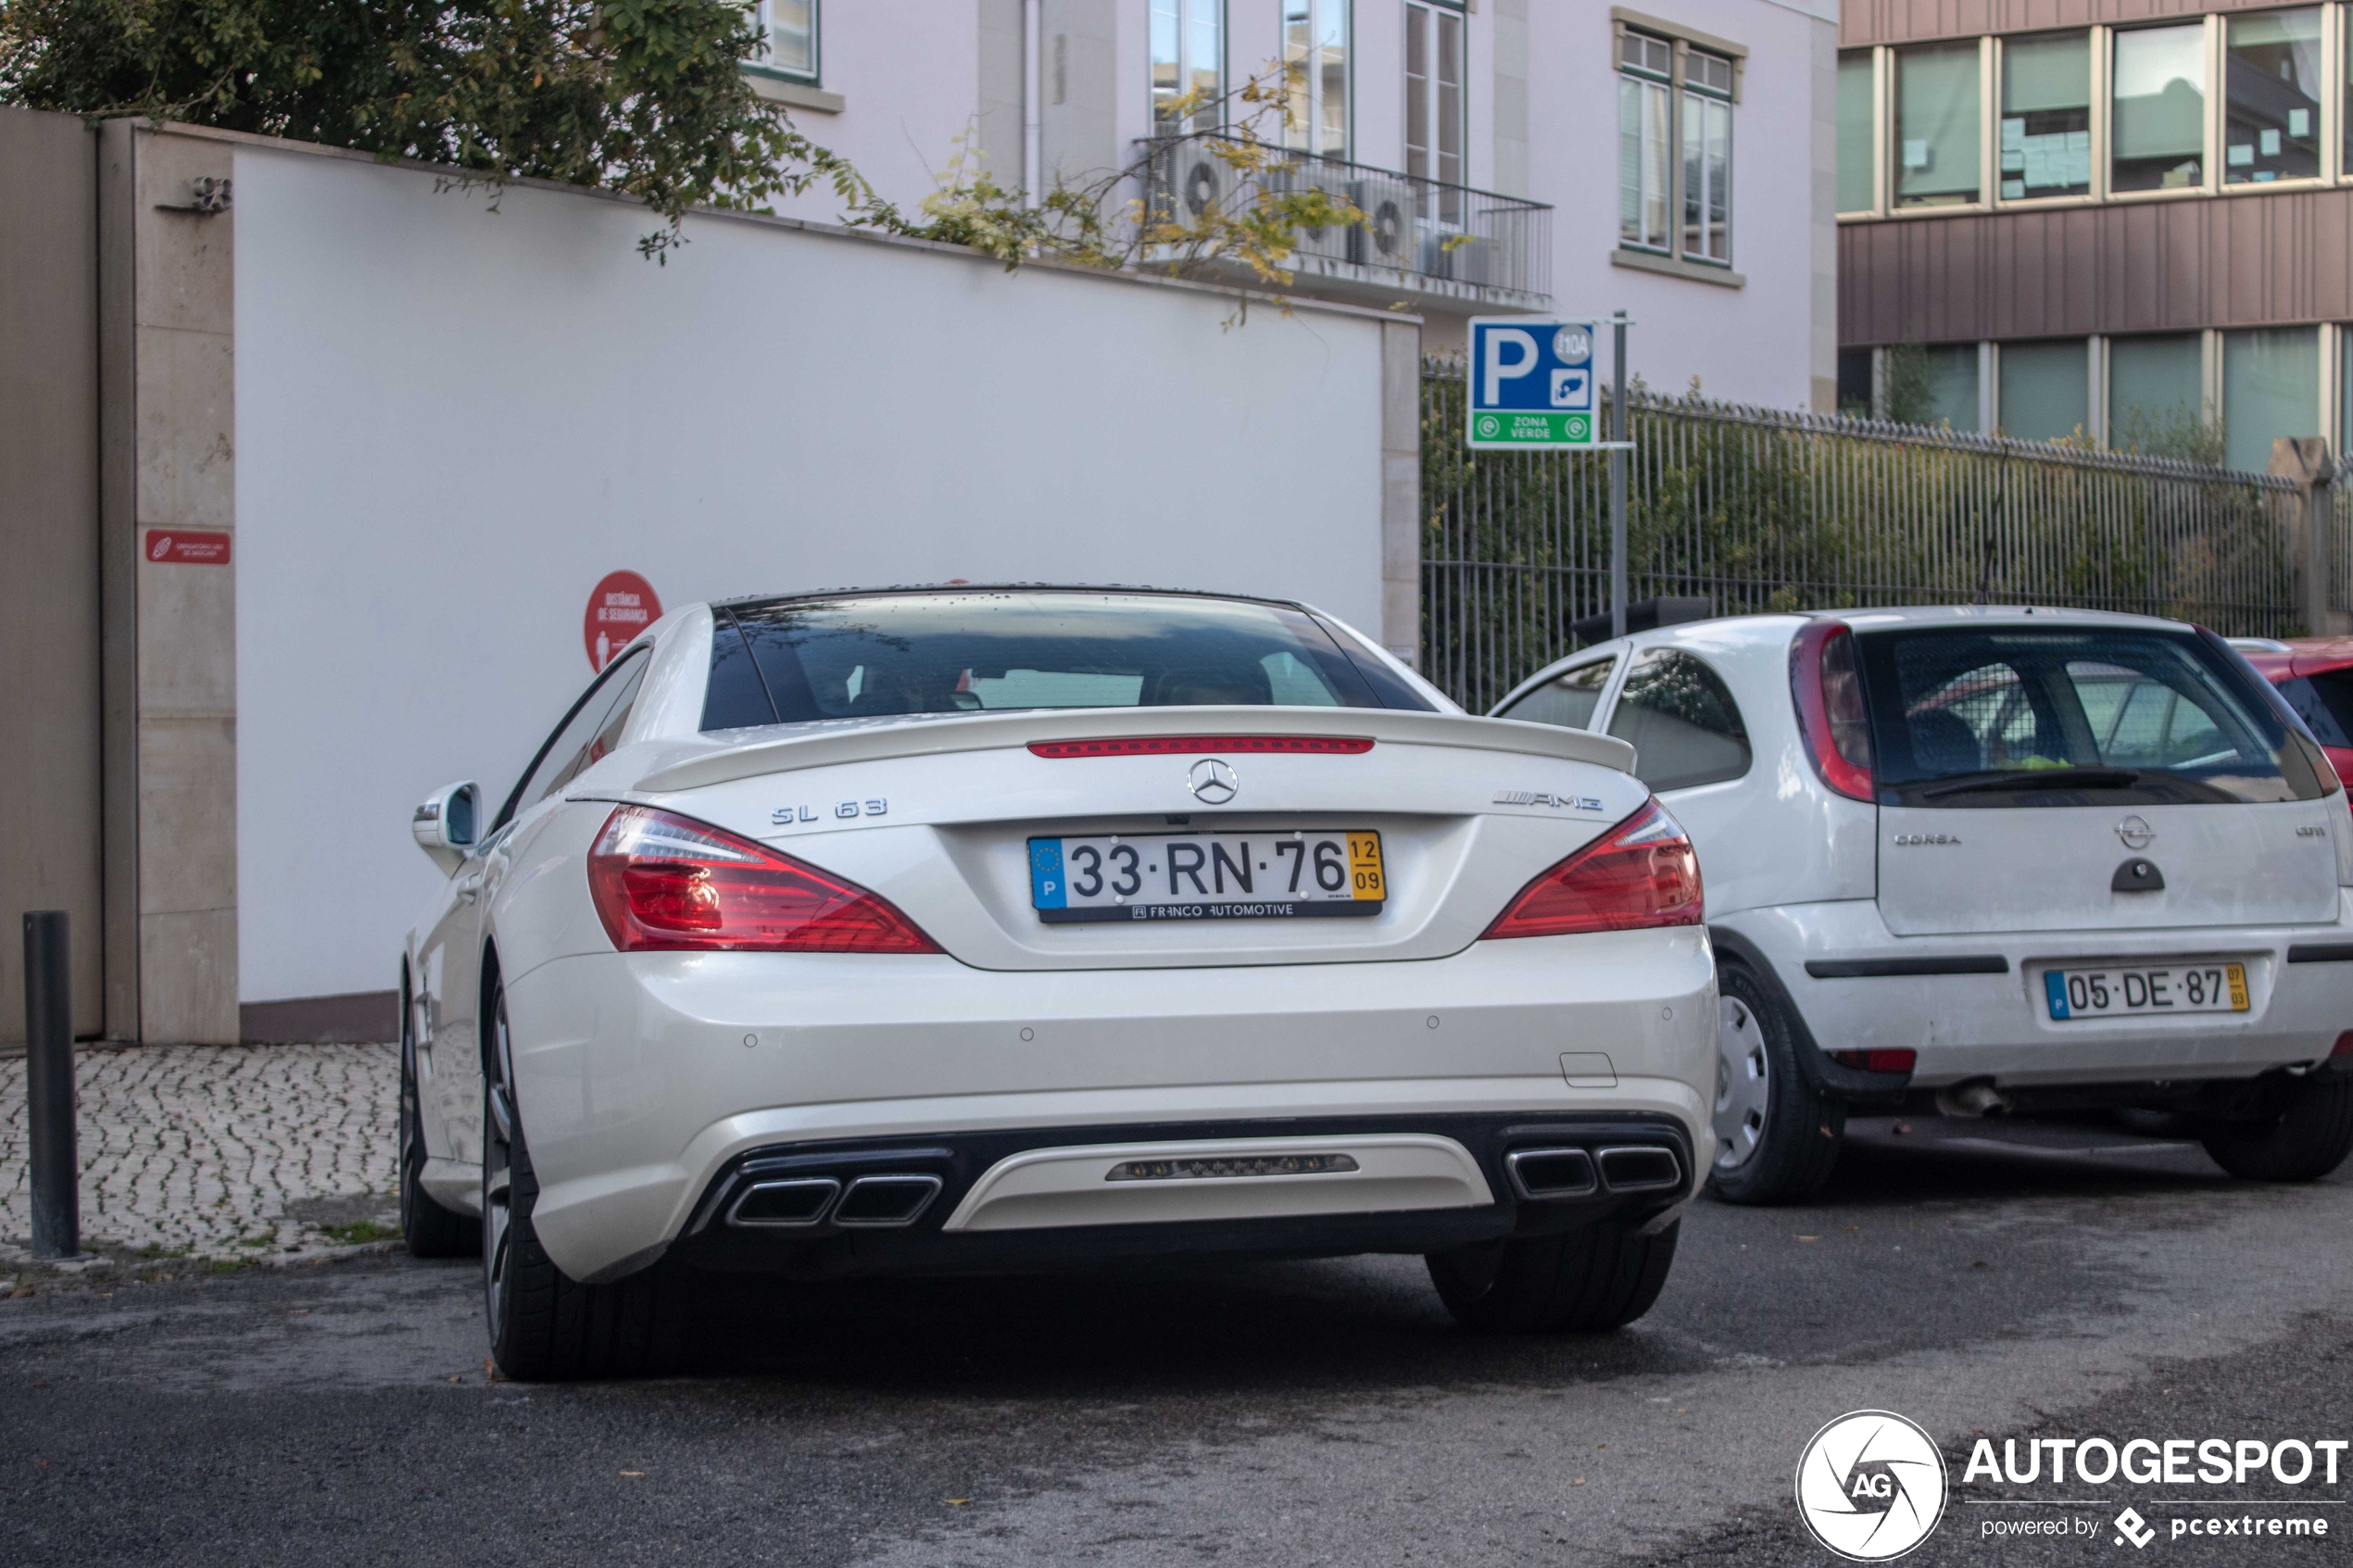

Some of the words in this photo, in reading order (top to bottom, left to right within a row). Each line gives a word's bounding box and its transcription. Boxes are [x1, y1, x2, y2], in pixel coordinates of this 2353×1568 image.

[1565, 333, 1590, 355] 10A
[1484, 328, 1539, 406] P
[1514, 416, 1549, 427] ZONA
[1510, 427, 1551, 438] VERDE
[605, 590, 641, 606] DISTÂNCIA
[598, 608, 609, 621] DE
[610, 608, 648, 623] SEGURANÇA
[1529, 792, 1604, 810] AMG
[772, 805, 819, 825] SL
[835, 797, 887, 819] 63
[1894, 834, 1962, 845] CORSA
[1351, 840, 1377, 858] 12
[1355, 872, 1379, 889] 09
[1043, 881, 1056, 896] P
[1151, 905, 1202, 917] FRANCO
[1209, 903, 1294, 917] AUTOMOTIVE
[2227, 968, 2241, 980] 07
[2055, 998, 2063, 1010] P
